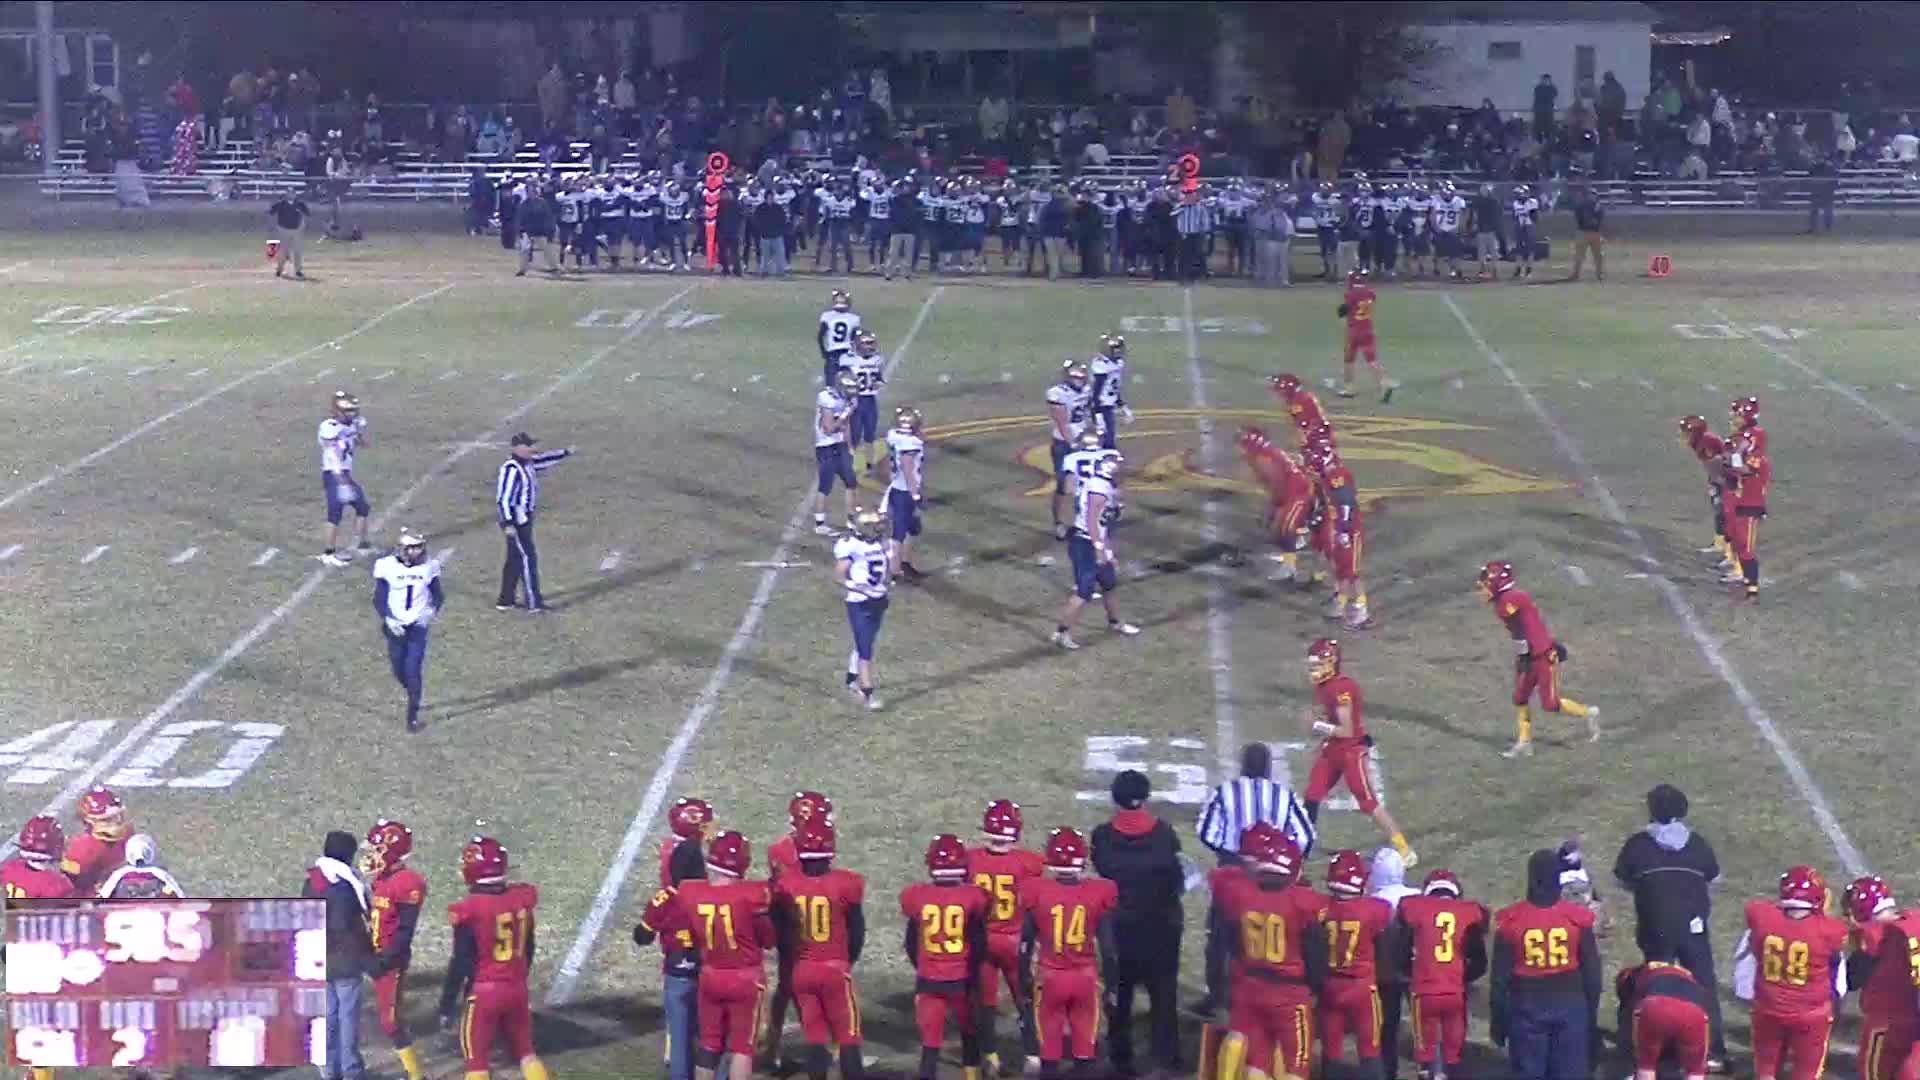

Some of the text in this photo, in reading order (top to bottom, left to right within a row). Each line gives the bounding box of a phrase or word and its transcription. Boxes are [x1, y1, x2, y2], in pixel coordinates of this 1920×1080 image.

[833, 321, 848, 343] 9
[405, 584, 414, 611] 1
[867, 560, 884, 586] 5
[0, 719, 286, 788] 40
[494, 908, 528, 961] 51
[697, 903, 738, 950] 71
[795, 896, 830, 943] 10
[921, 904, 964, 953] 29
[1051, 904, 1087, 955] 14
[1241, 910, 1286, 962] 60
[1434, 912, 1456, 962] 3
[1523, 928, 1569, 969] 66
[1763, 935, 1809, 985] 68
